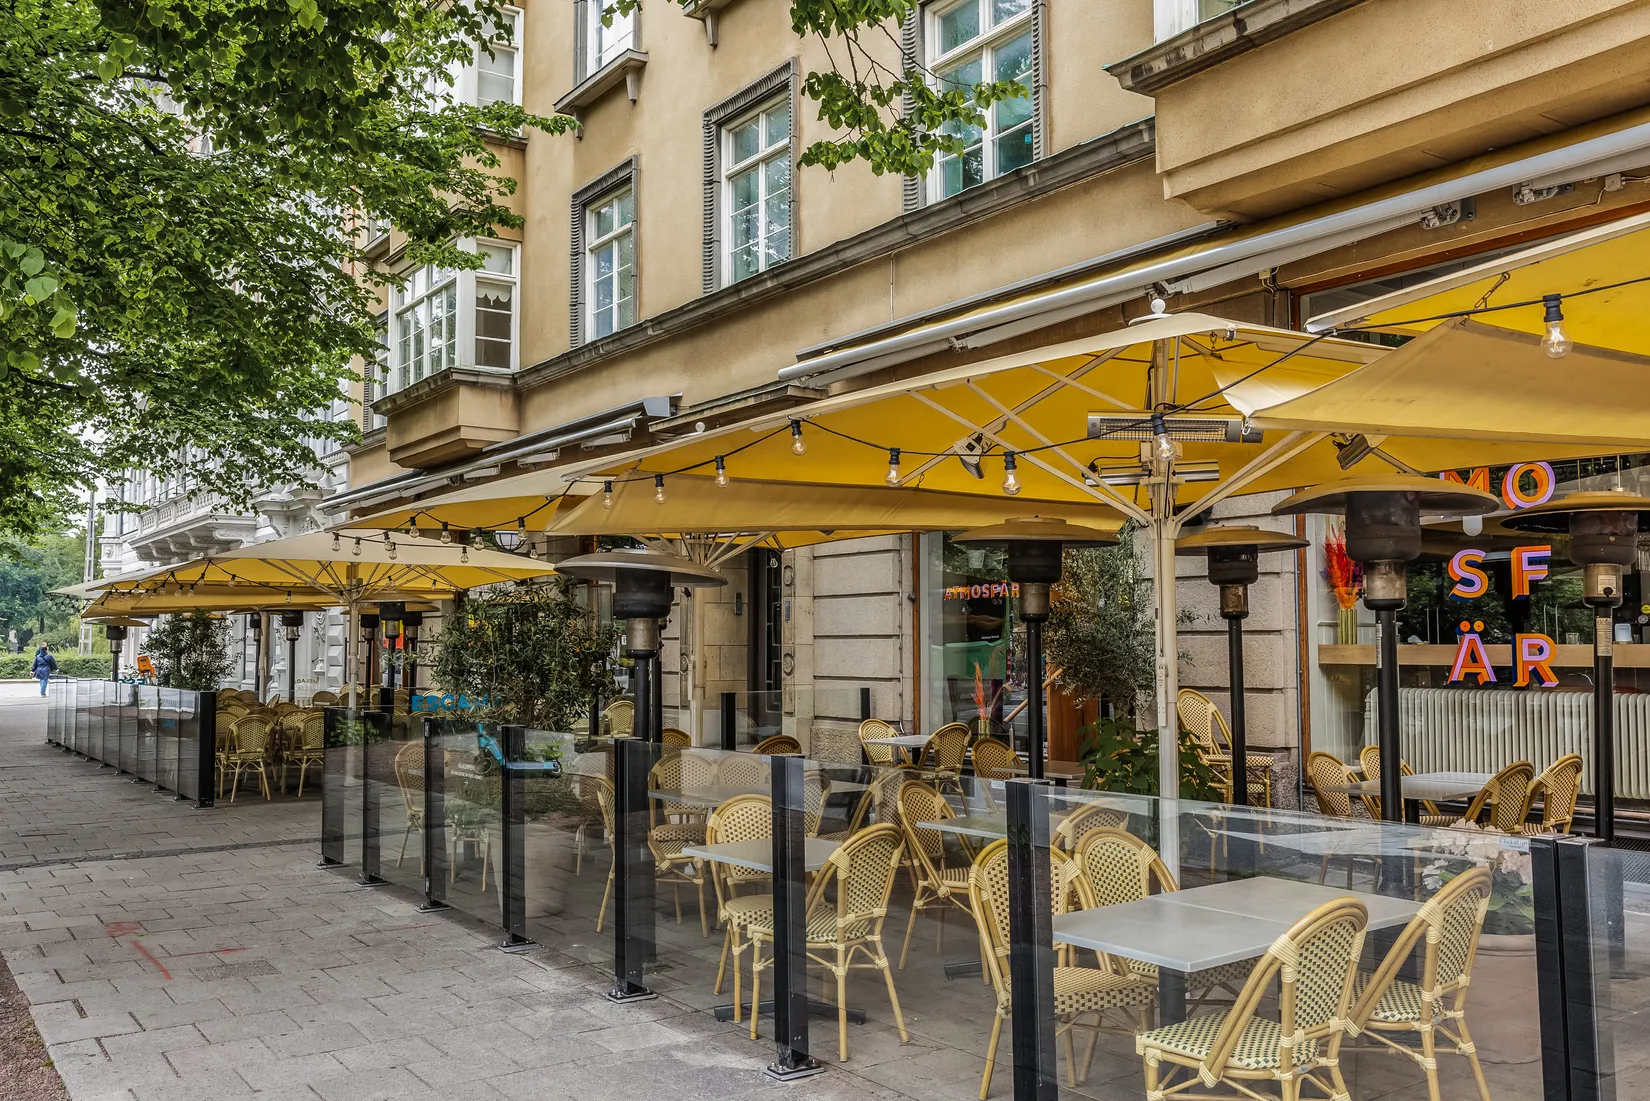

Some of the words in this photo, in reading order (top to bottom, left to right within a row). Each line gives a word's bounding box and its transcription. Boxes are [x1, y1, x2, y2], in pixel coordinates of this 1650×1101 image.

[944, 579, 1020, 600] ATMOSFÄR
[1447, 545, 1552, 602] SF
[1447, 620, 1560, 688] ÄR
